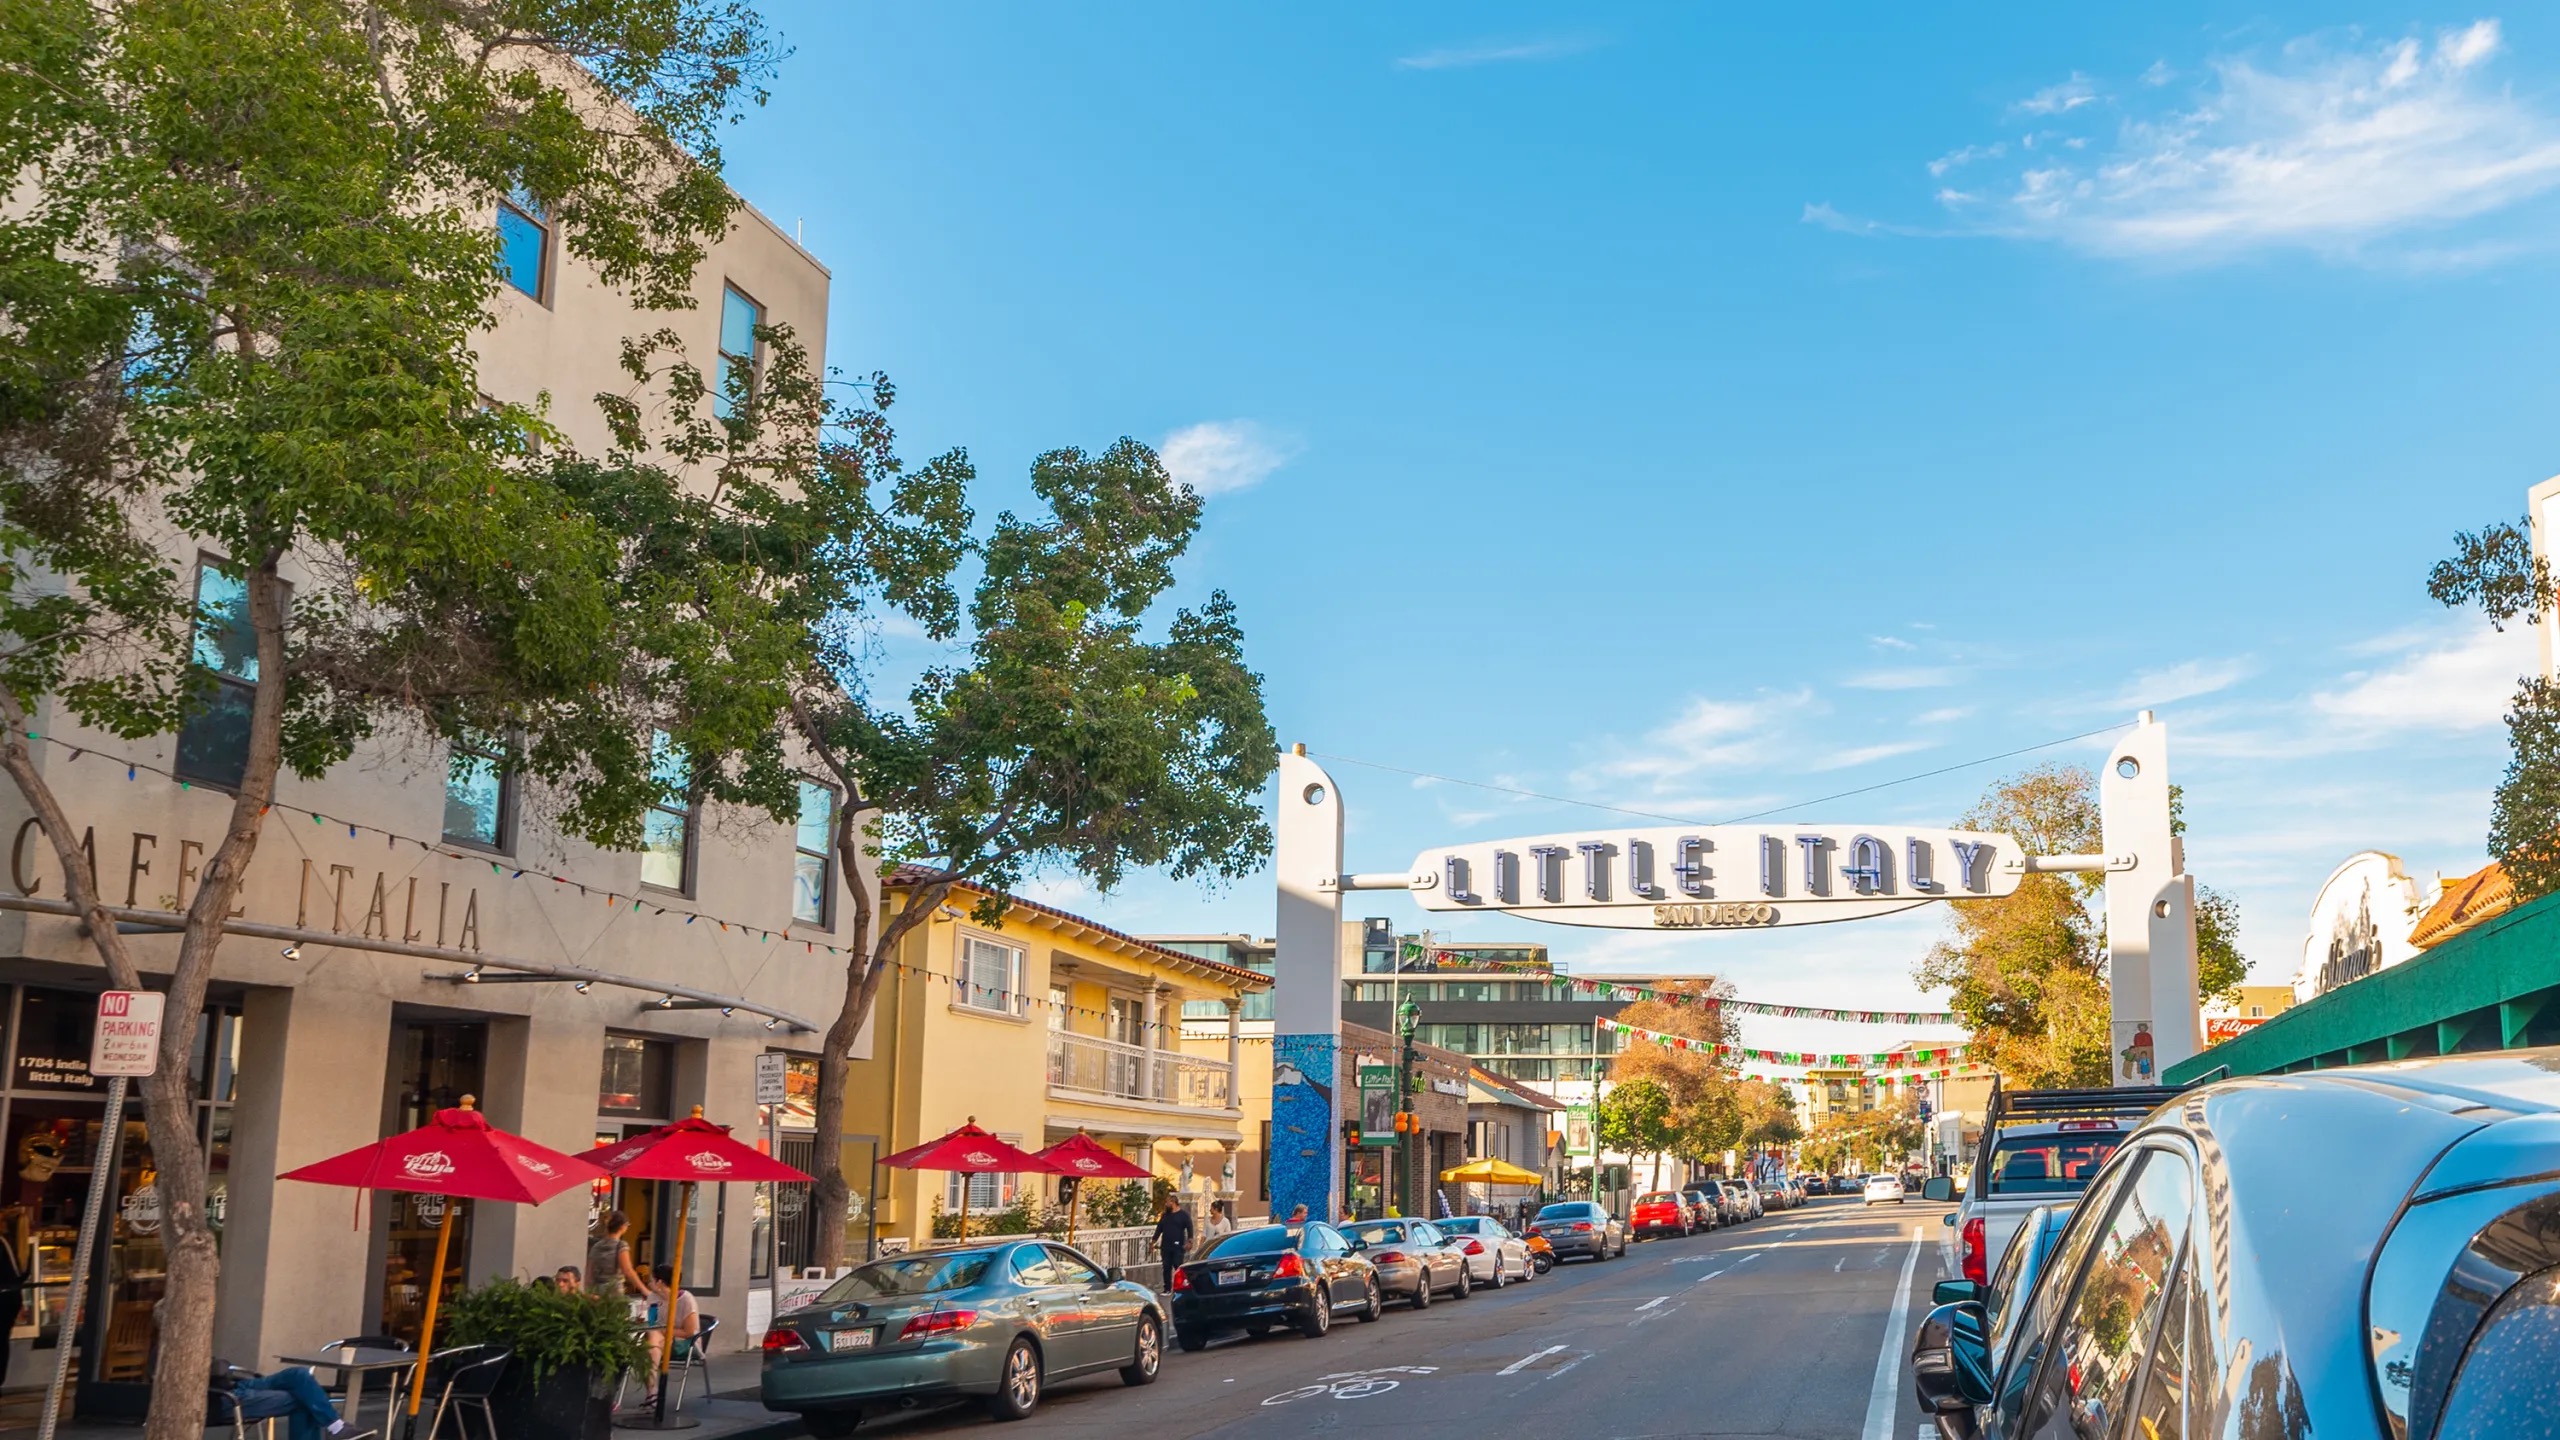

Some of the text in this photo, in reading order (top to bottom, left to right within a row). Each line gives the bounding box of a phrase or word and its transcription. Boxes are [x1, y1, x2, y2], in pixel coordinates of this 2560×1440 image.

[1444, 833, 1982, 901] LITTLE ITALY
[297, 859, 481, 950] ITALIA
[1653, 903, 1773, 926] SAN DIEGO
[104, 995, 127, 1014] NO
[102, 1021, 155, 1037] PARKING
[19, 1057, 54, 1069] 1704
[29, 1072, 94, 1087] little italy
[416, 1203, 462, 1216] itala
